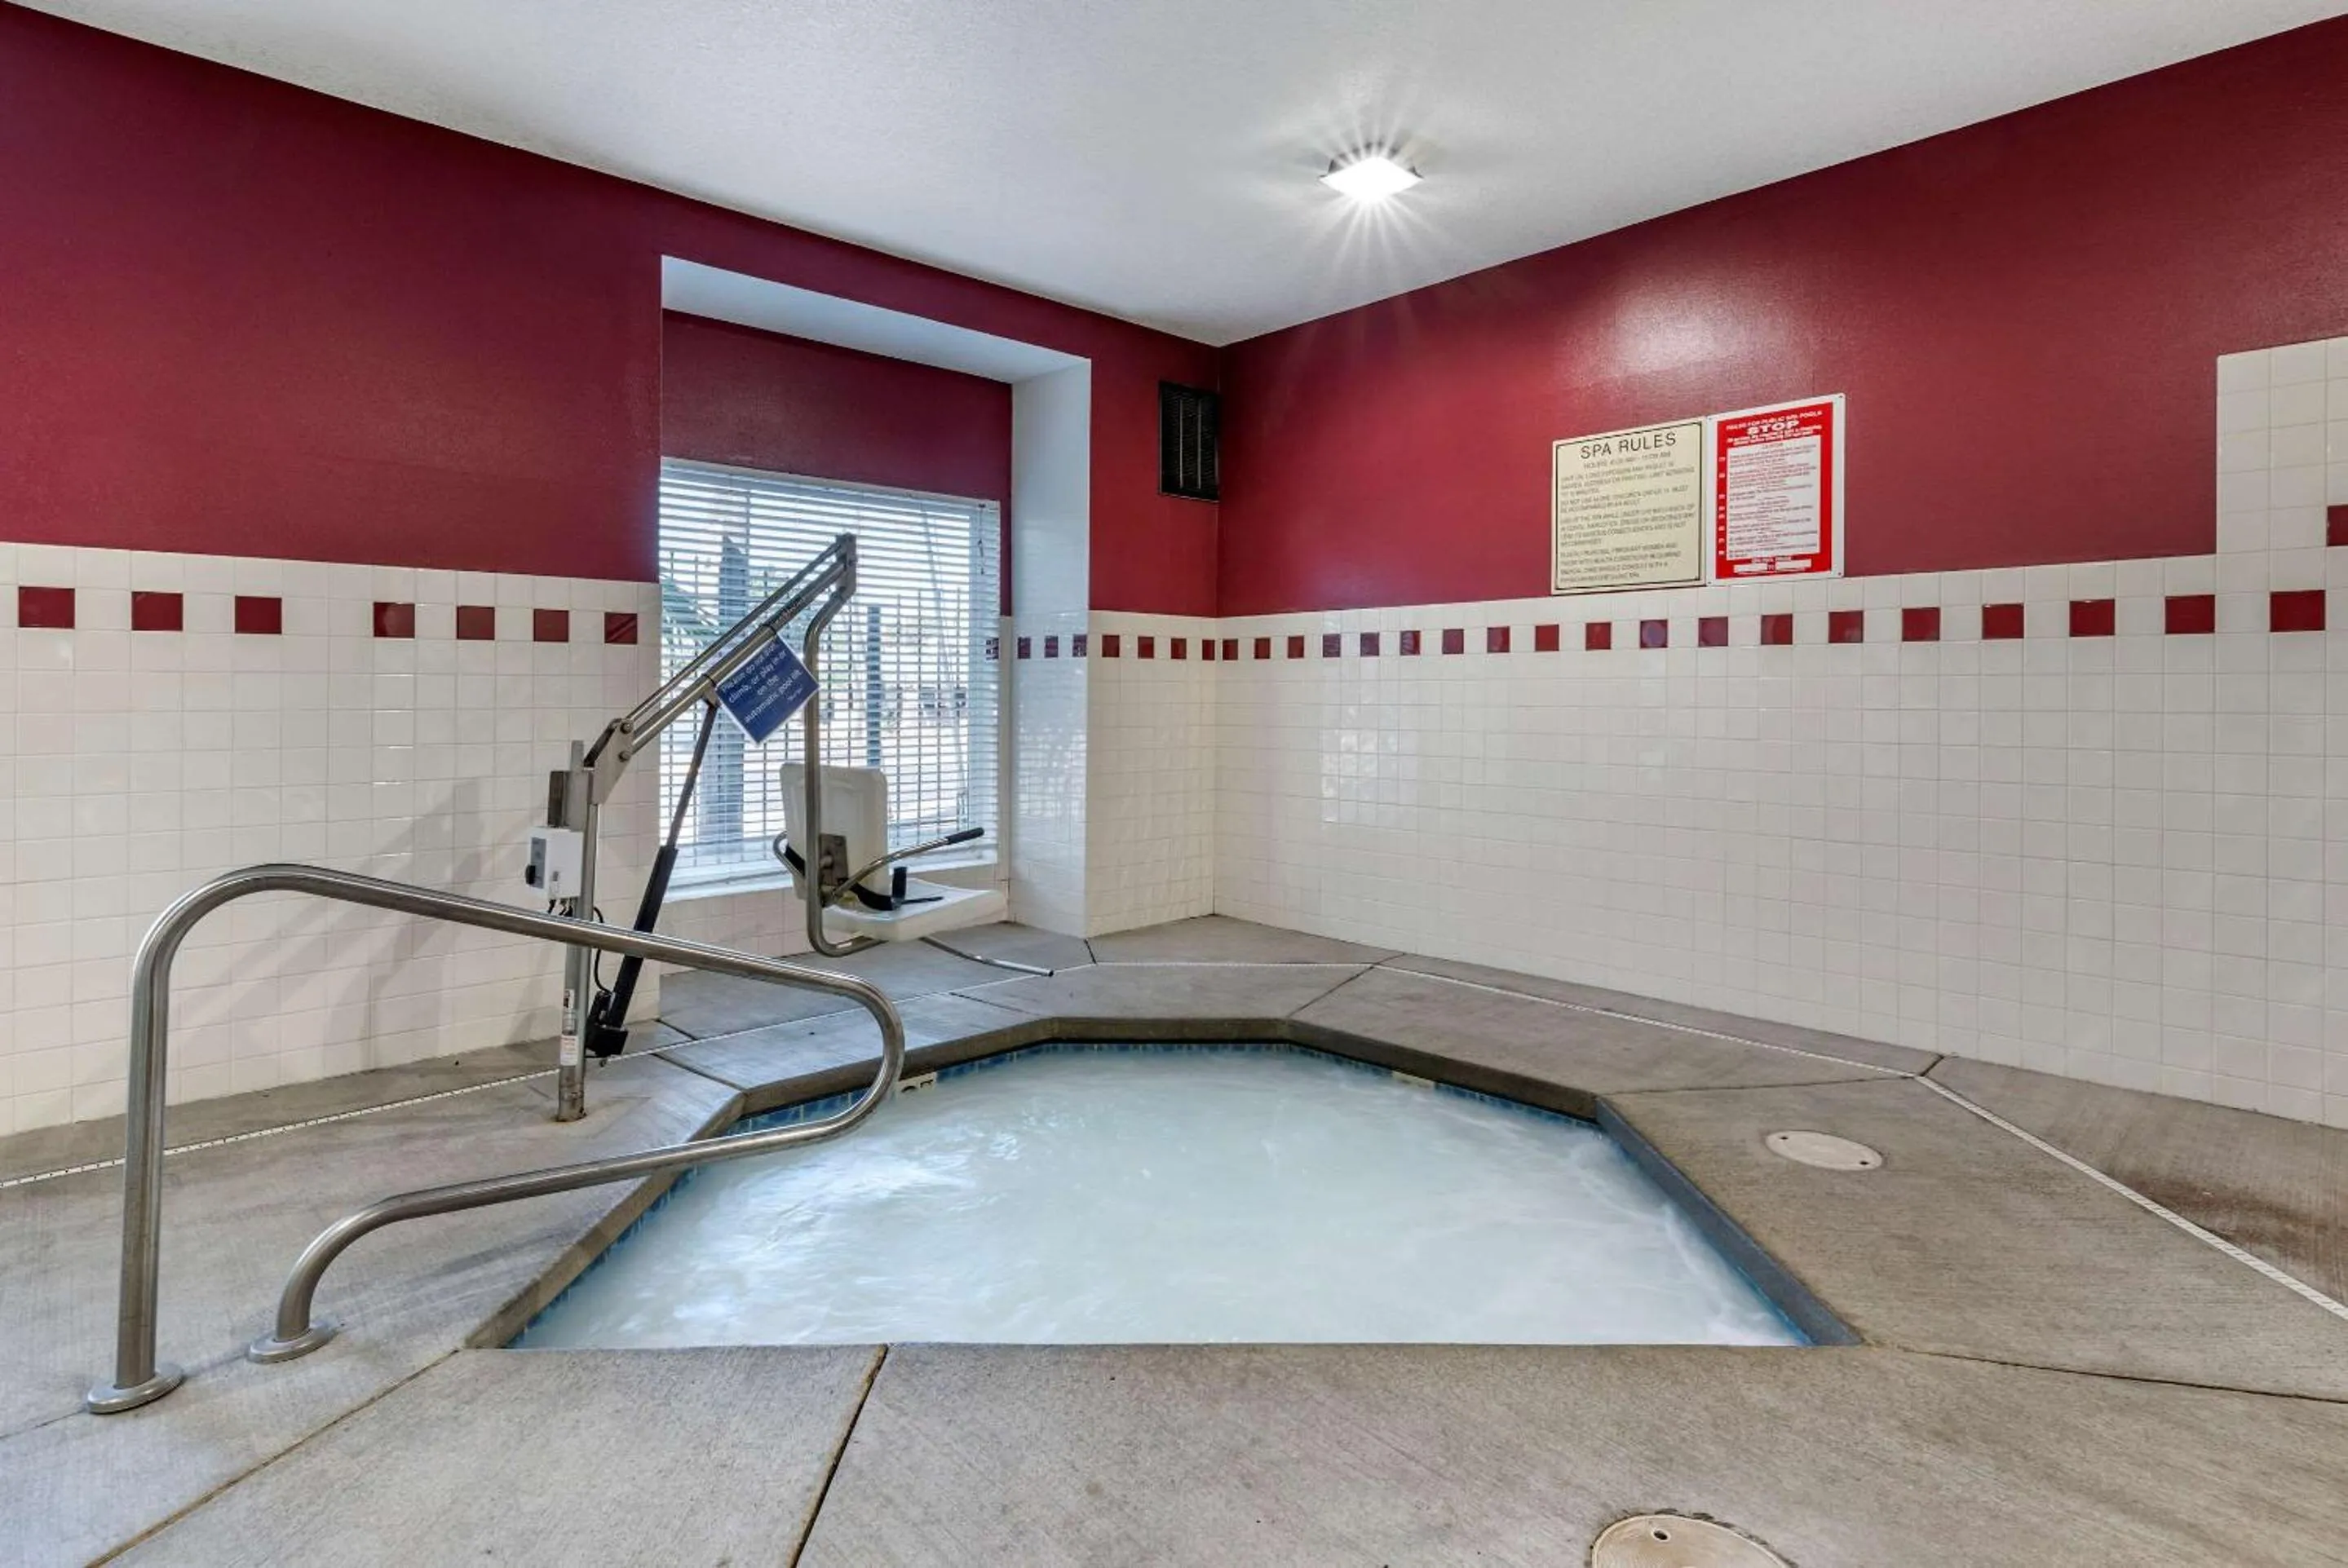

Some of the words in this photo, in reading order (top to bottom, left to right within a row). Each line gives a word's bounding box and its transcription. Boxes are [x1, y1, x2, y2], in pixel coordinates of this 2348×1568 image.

[1747, 421, 1799, 435] STOP
[1581, 443, 1612, 459] SPA
[1619, 432, 1676, 452] RULES
[766, 674, 779, 687] the
[778, 678, 794, 695] pool
